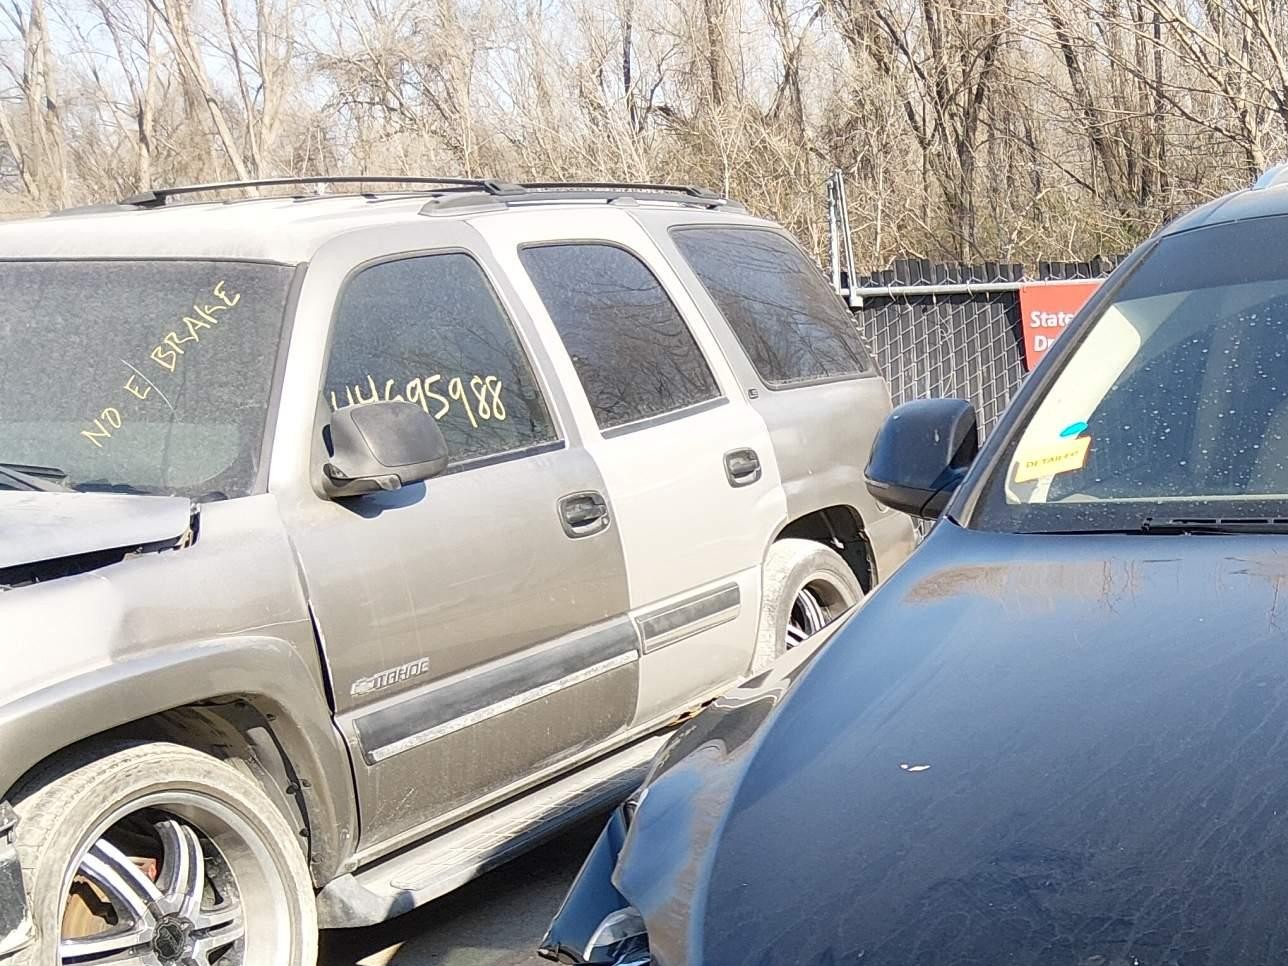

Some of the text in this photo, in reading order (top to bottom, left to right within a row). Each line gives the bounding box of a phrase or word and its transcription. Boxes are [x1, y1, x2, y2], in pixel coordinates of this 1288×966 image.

[80, 407, 122, 448] NO
[150, 281, 241, 373] BRAKE
[372, 656, 430, 689] TAHOE
